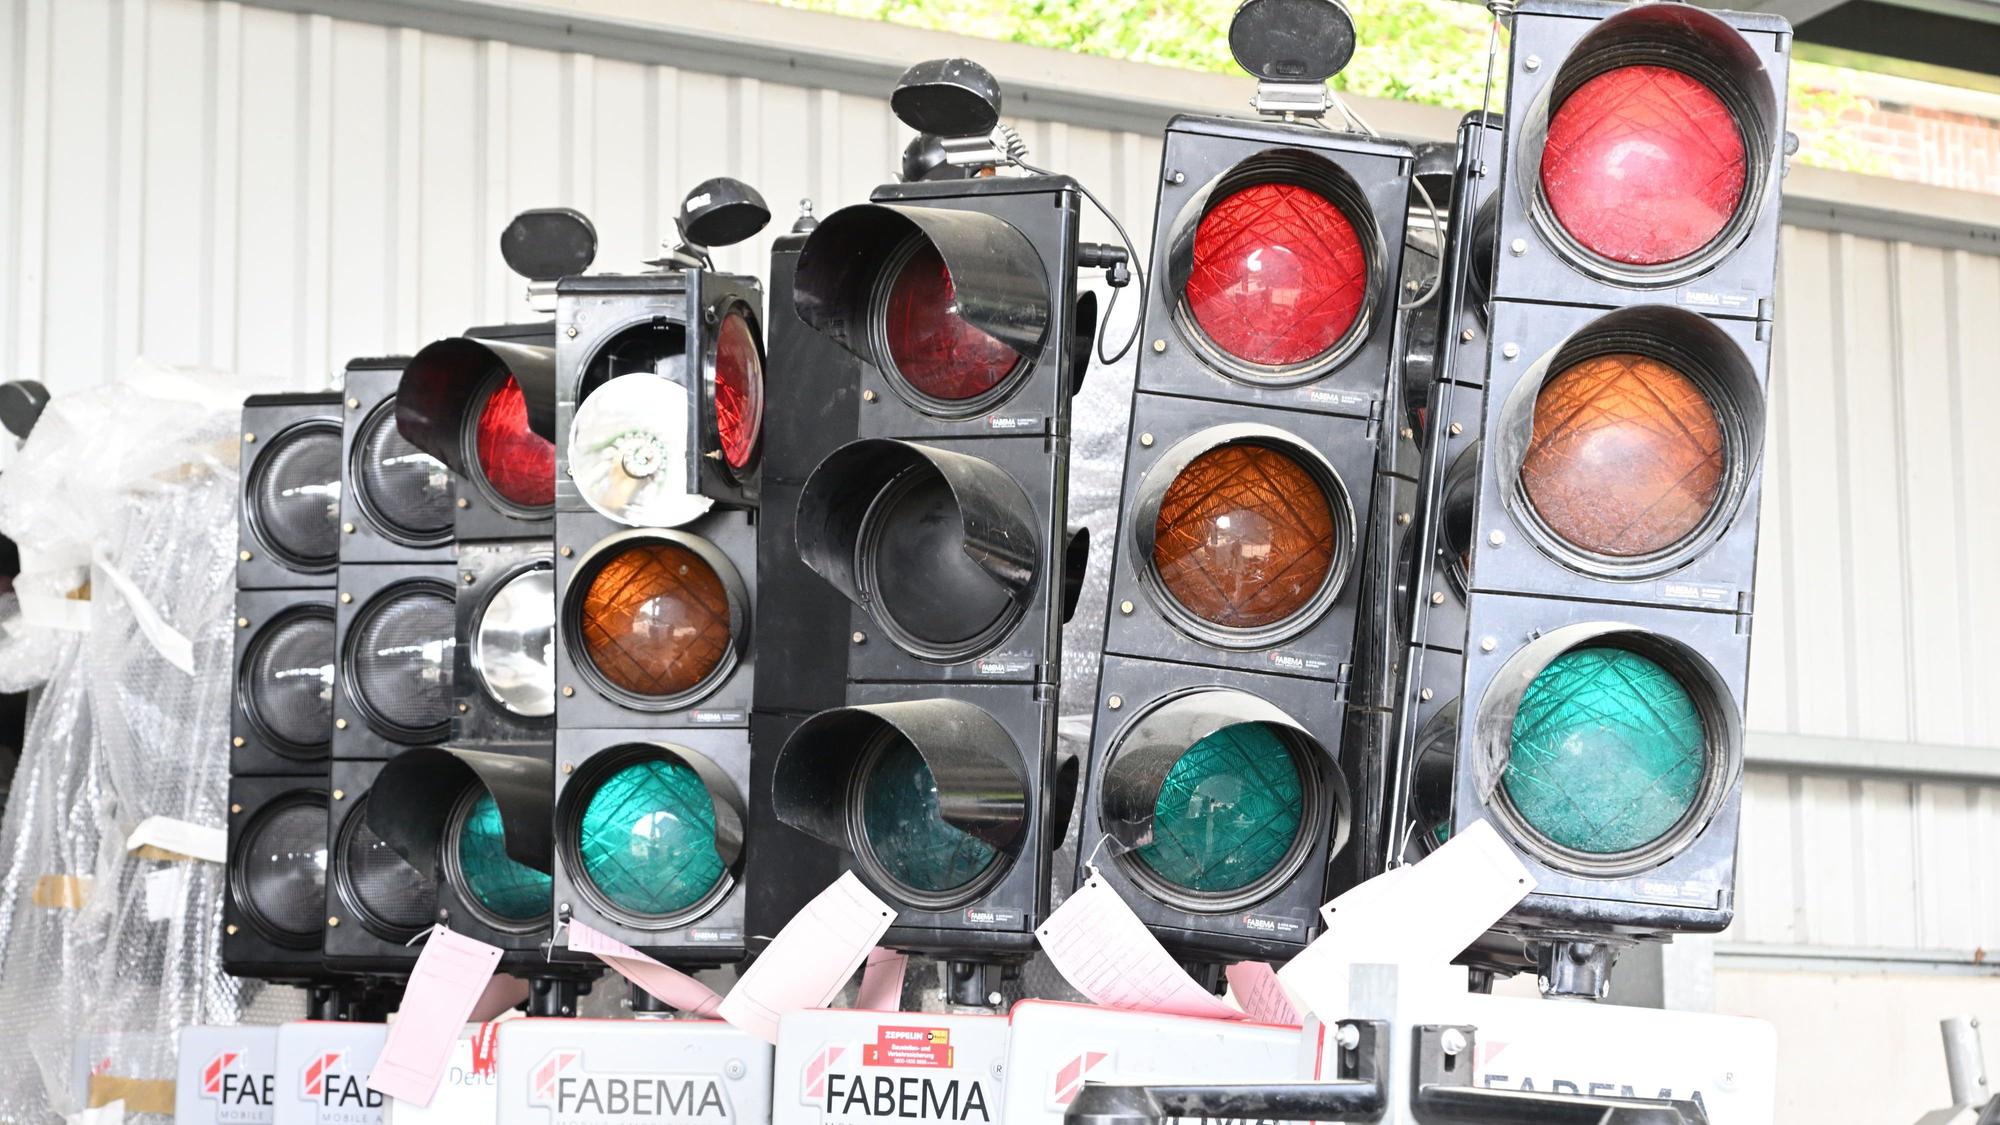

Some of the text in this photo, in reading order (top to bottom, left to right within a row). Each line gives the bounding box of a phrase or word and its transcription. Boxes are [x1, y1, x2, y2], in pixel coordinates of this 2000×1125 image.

[1247, 918, 1275, 929] FABEMA
[884, 1031, 924, 1040] ZEPPELIN
[558, 1077, 726, 1117] FABEMA
[826, 1073, 990, 1122] FABEMA
